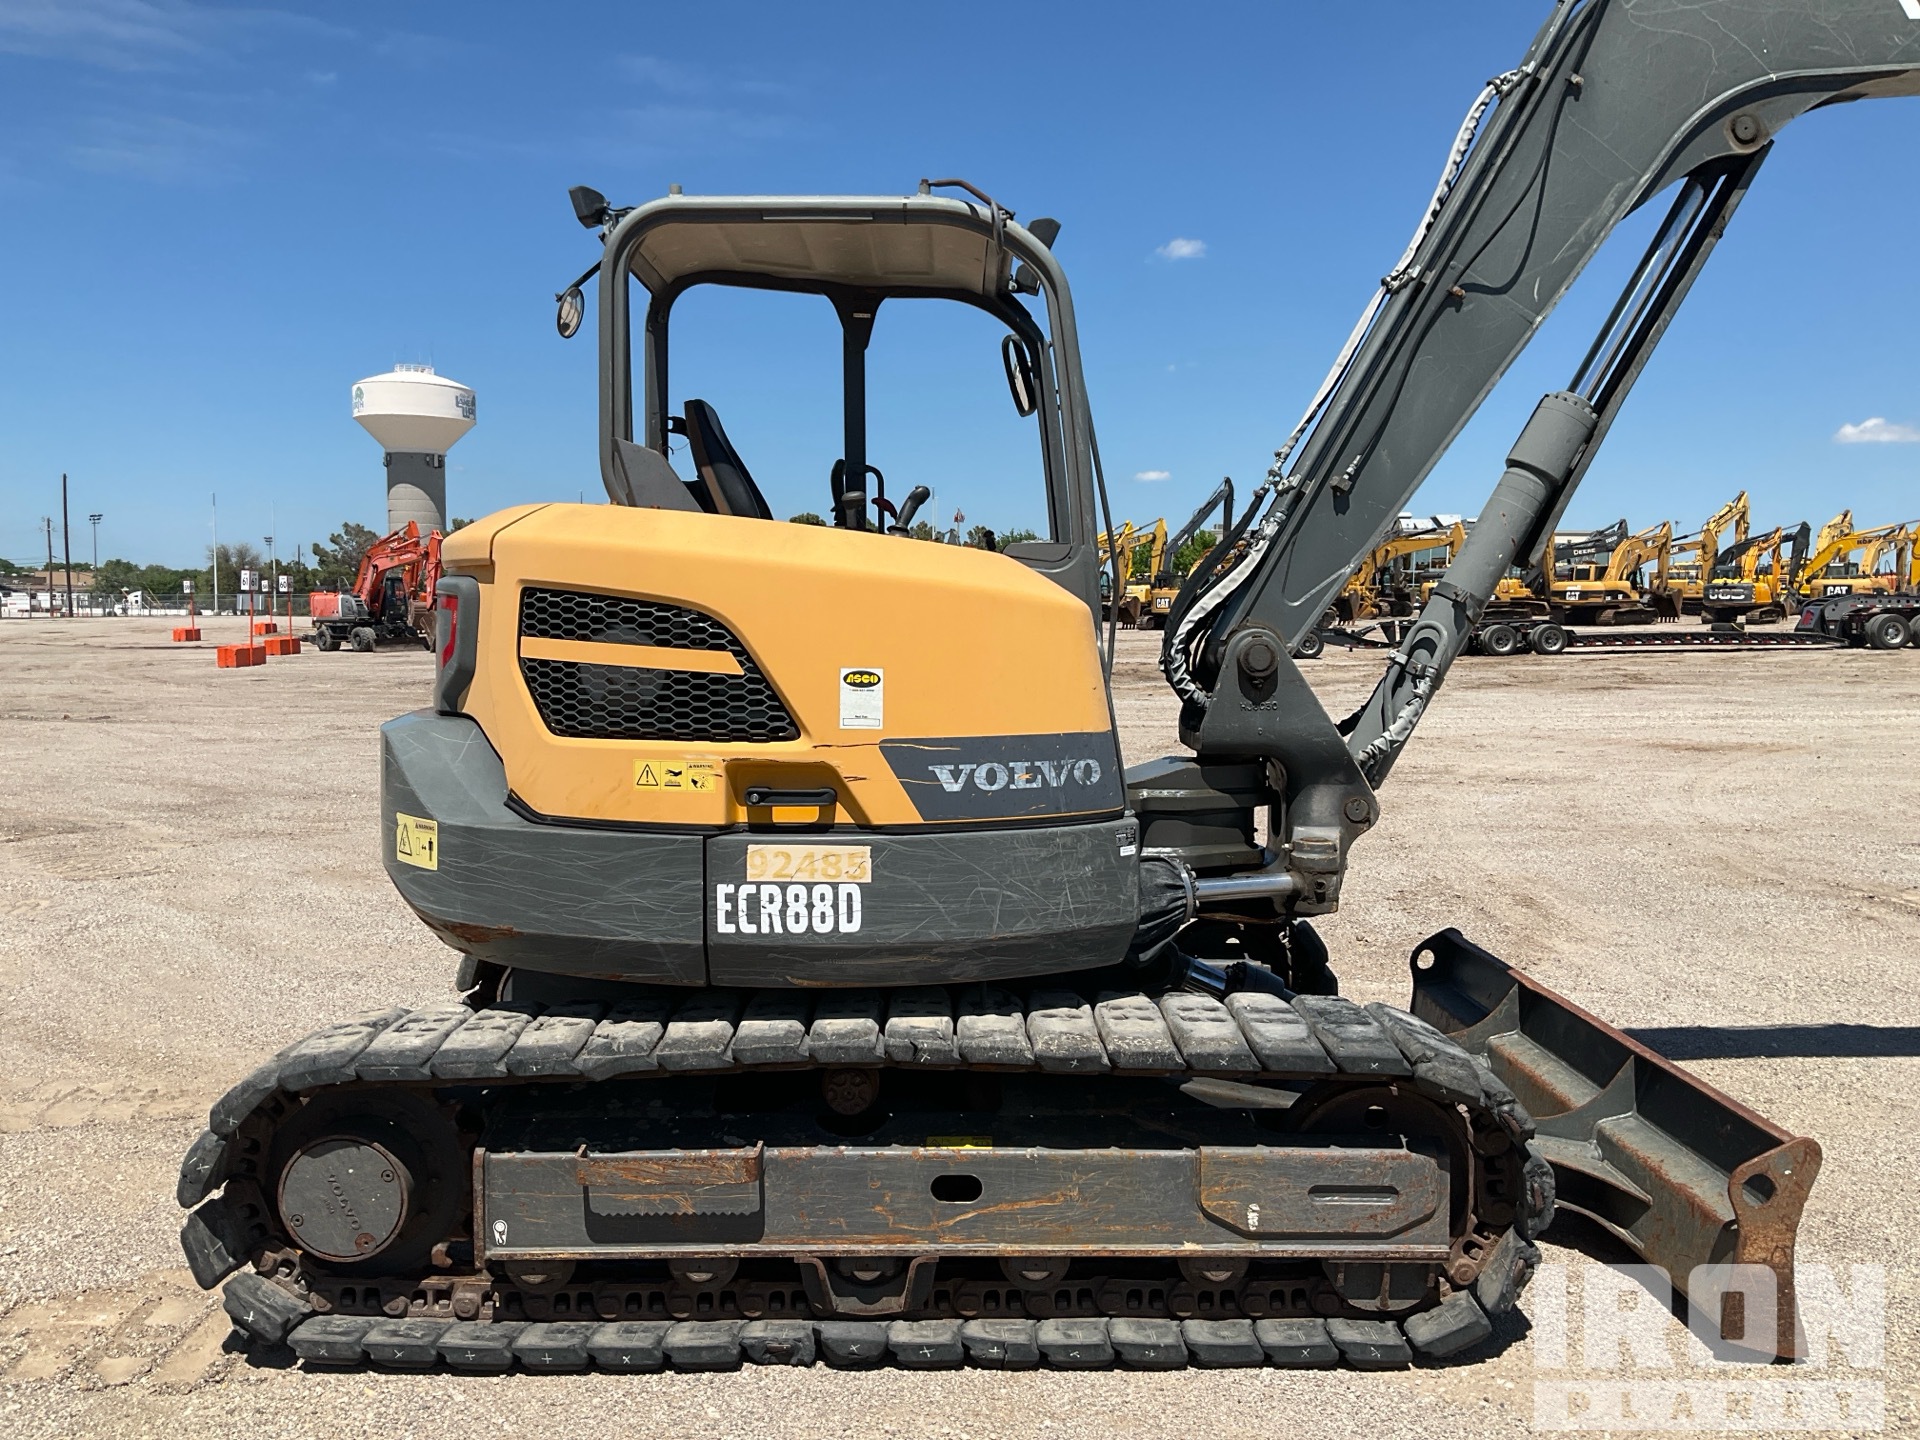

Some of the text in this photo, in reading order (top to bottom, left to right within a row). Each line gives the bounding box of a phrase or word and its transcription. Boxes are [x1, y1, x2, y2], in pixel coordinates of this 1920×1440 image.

[1573, 548, 1596, 556] DEERE
[1827, 586, 1849, 596] CAT
[1156, 598, 1170, 609] CAT
[928, 758, 1102, 793] VOLVO
[748, 850, 867, 881] 92485
[716, 883, 862, 934] ECR88D
